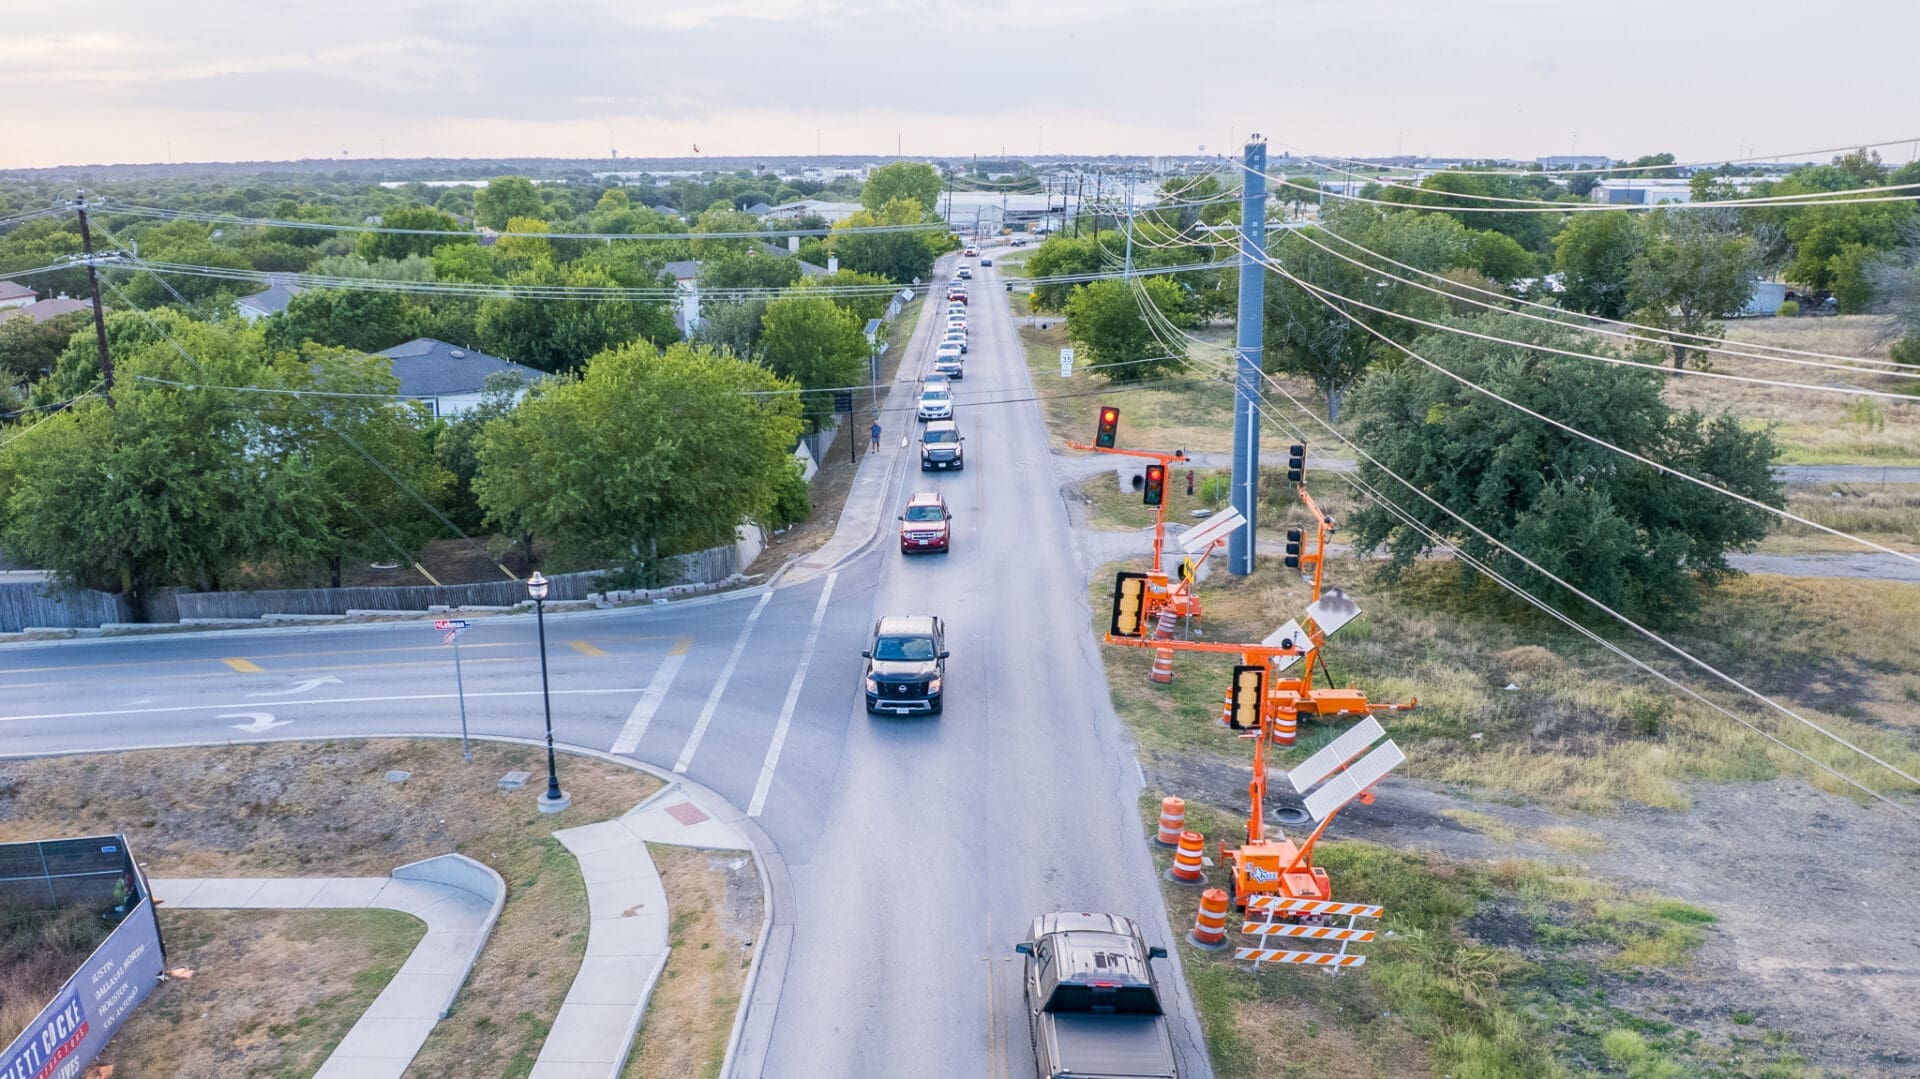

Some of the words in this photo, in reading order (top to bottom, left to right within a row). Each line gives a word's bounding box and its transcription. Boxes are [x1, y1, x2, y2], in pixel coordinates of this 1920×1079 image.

[92, 959, 114, 985] AUSTIN
[123, 944, 145, 970] WORTH
[99, 982, 129, 1016] HOUSTON
[103, 1014, 116, 1031] SAN
[116, 986, 138, 1019] ANTONIO
[42, 999, 80, 1056] COCKE
